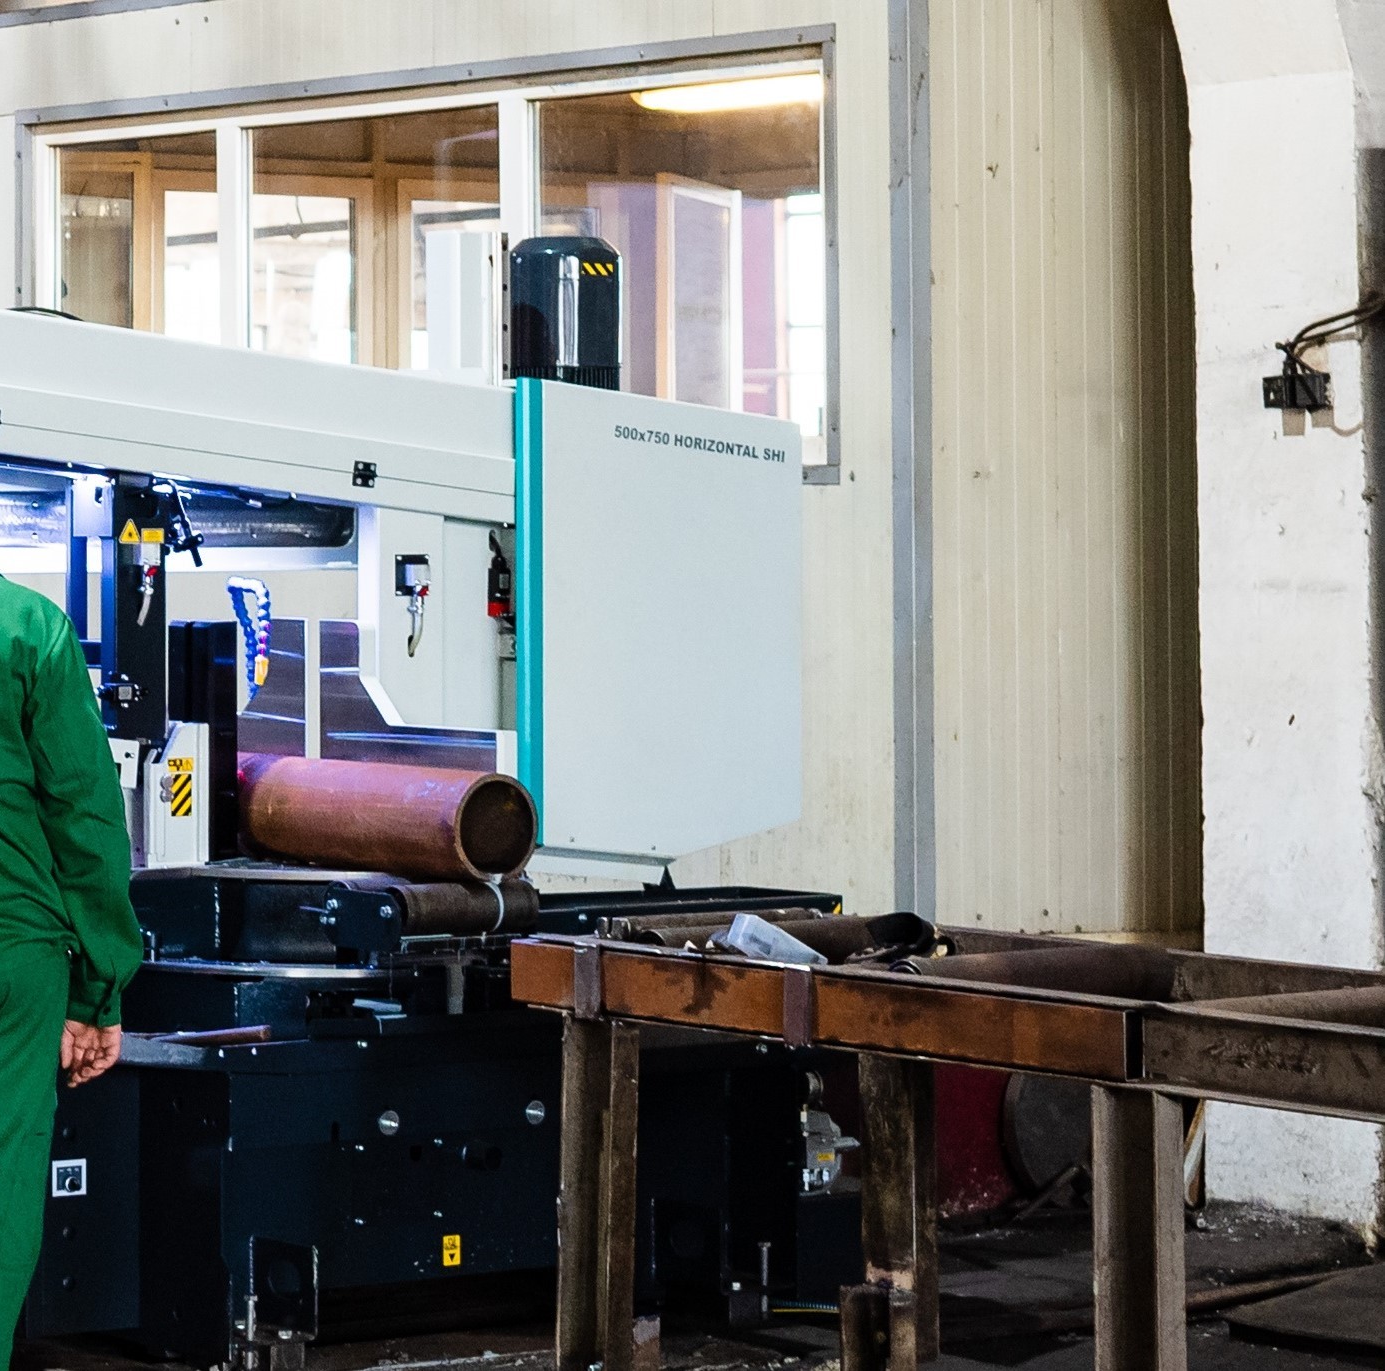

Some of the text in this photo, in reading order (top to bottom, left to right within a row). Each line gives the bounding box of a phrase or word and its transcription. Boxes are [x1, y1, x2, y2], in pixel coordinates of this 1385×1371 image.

[614, 425, 785, 463] 500x750 HORIZONTAL SHI
